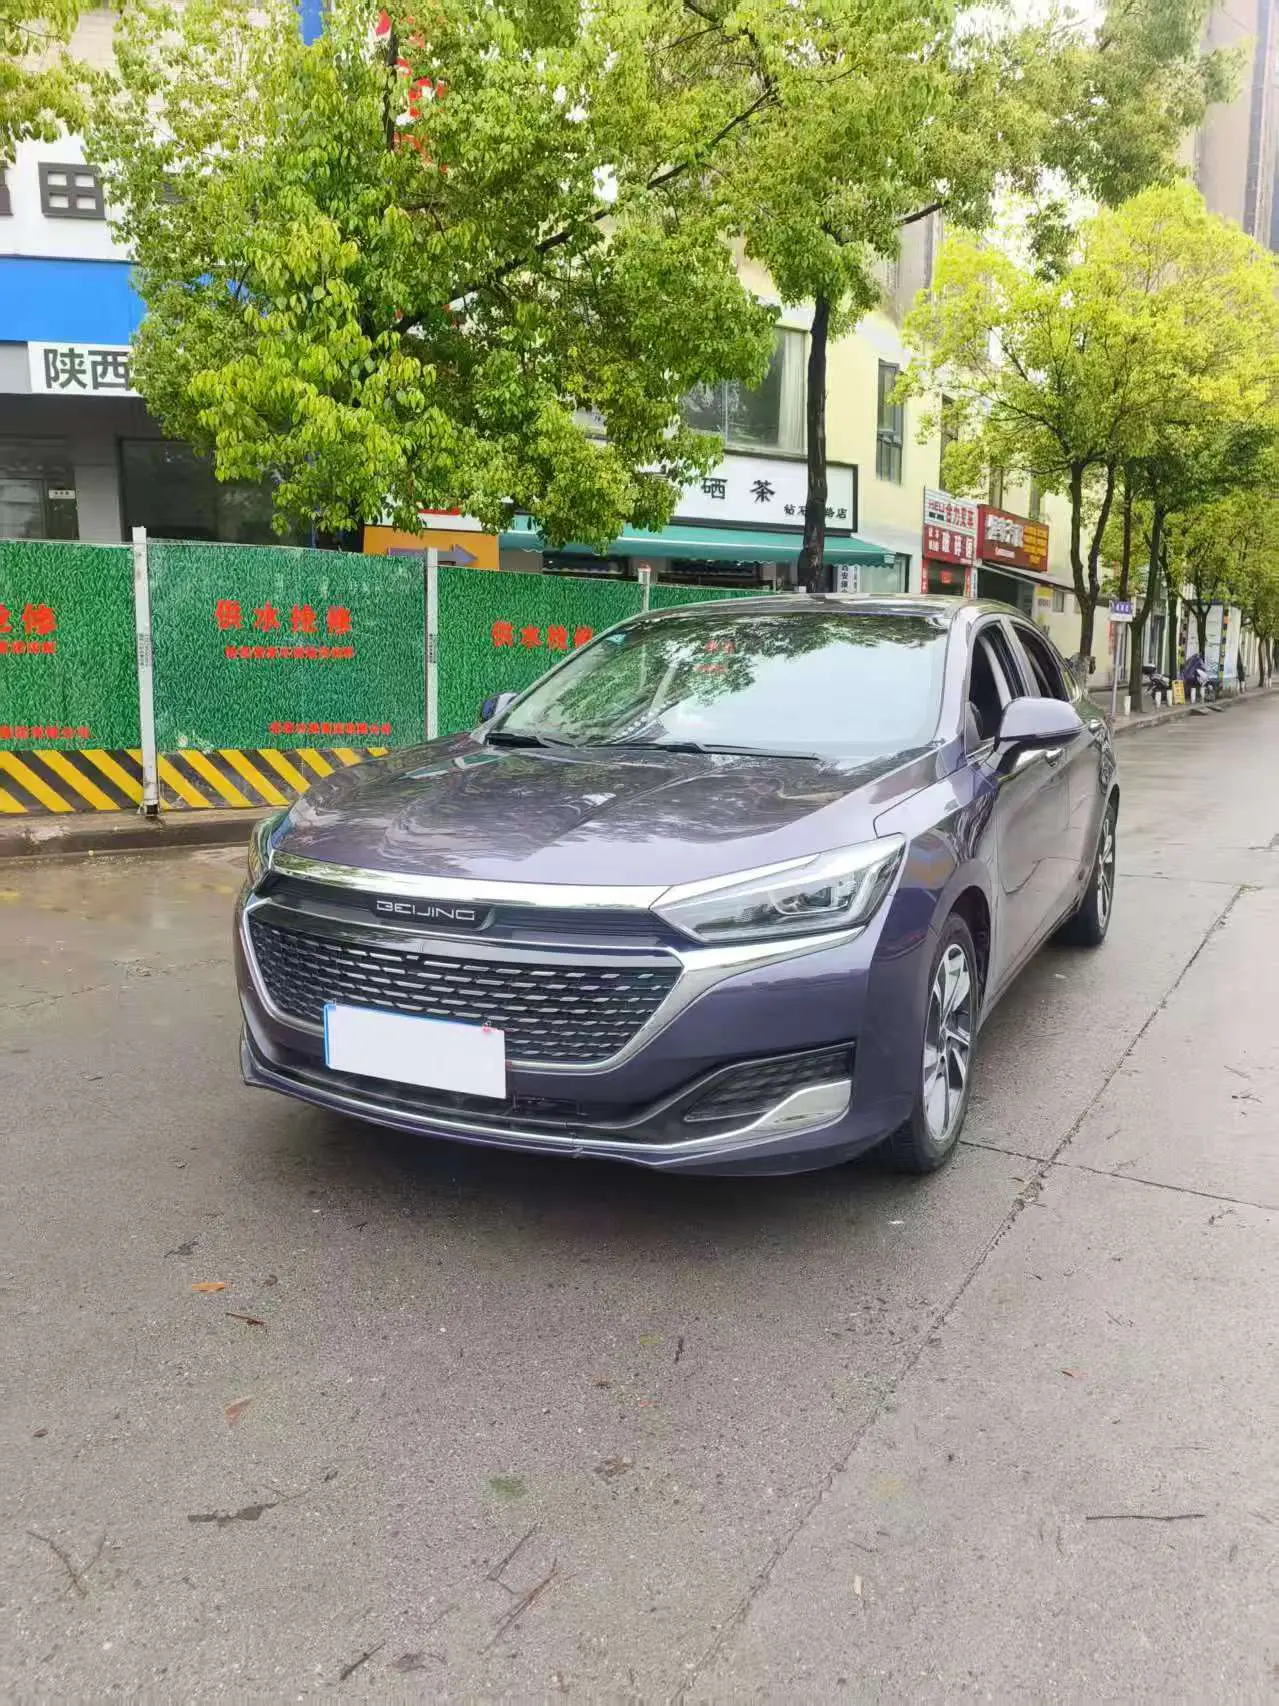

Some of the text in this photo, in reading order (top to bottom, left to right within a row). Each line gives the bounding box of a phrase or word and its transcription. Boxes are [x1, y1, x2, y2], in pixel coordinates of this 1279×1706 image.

[43, 347, 131, 392] 陕西
[700, 477, 776, 503] 硒茶
[376, 899, 476, 921] BEIJING
